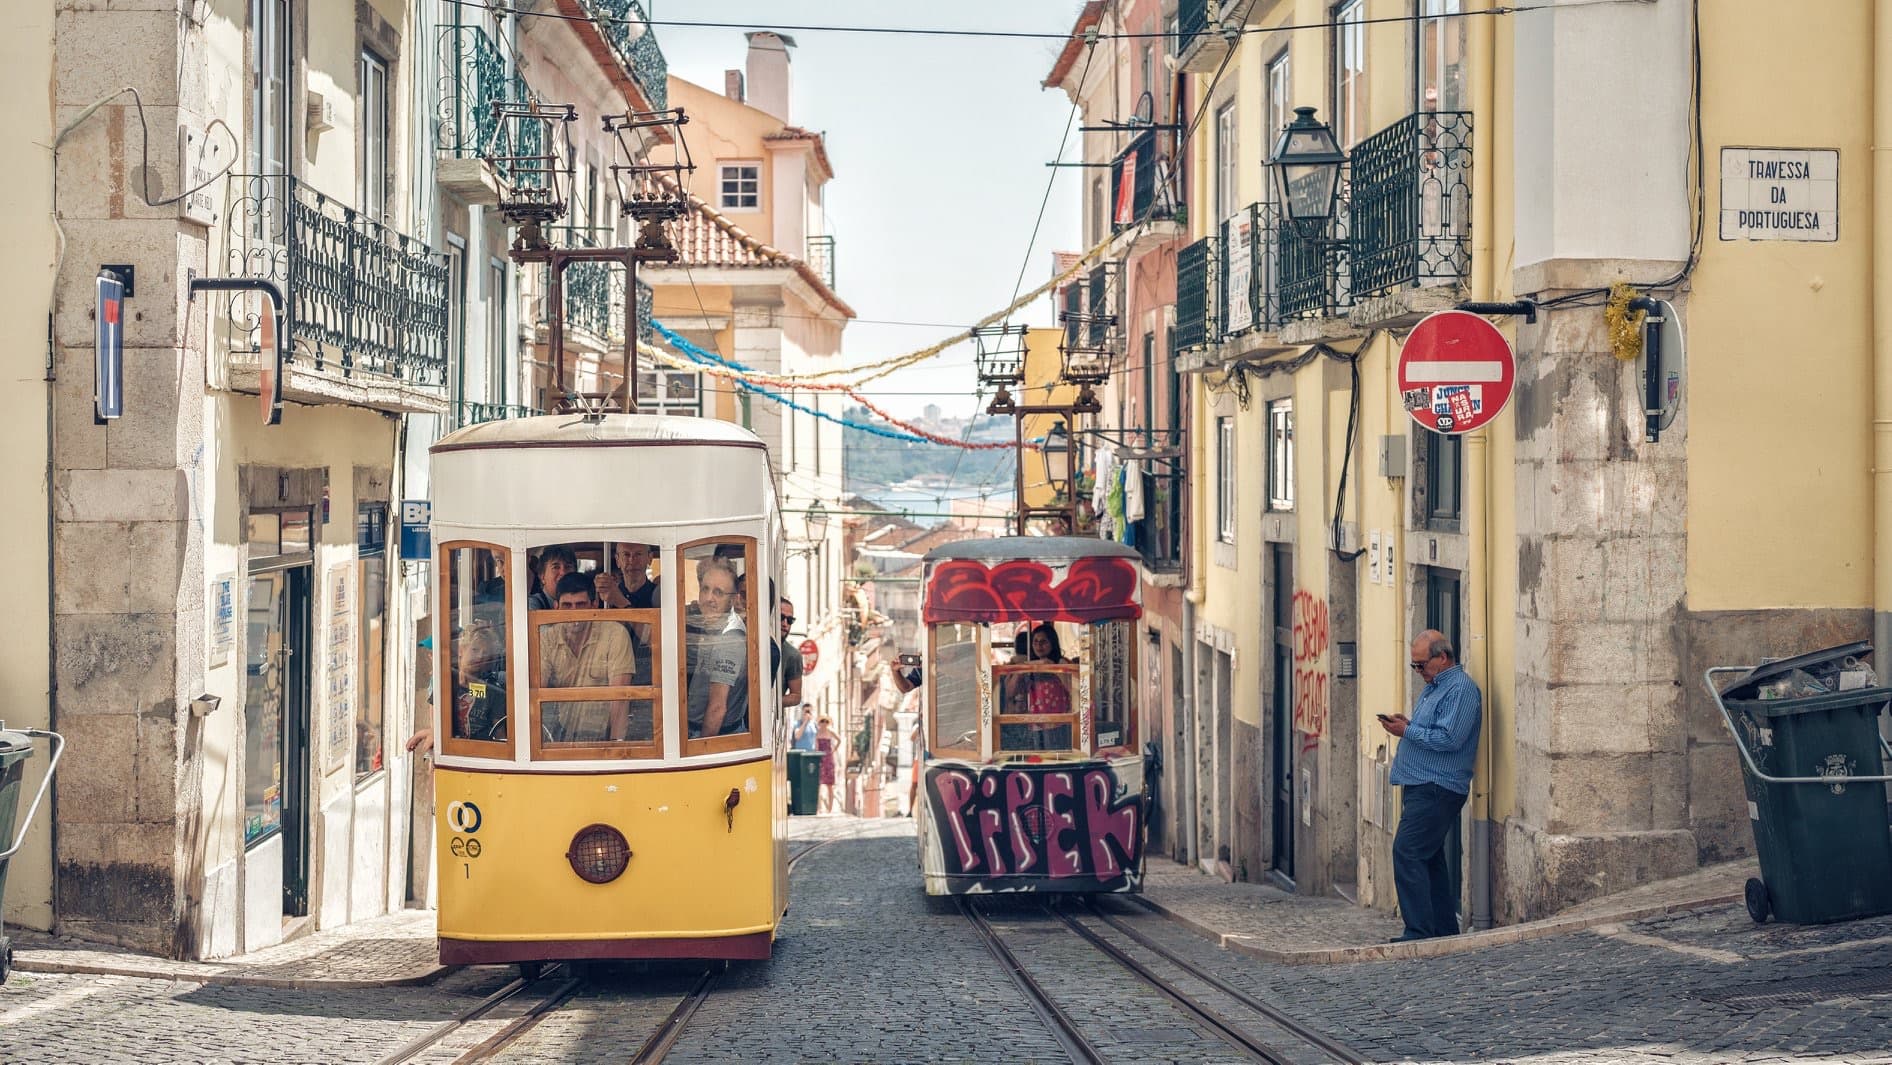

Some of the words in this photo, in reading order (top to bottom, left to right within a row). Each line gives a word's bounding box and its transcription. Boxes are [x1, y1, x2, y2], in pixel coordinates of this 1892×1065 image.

[1748, 160, 1810, 179] TRAVESSA
[1771, 186, 1787, 204] DA
[1739, 210, 1820, 230] PORTUGUESA
[463, 863, 470, 880] 1
